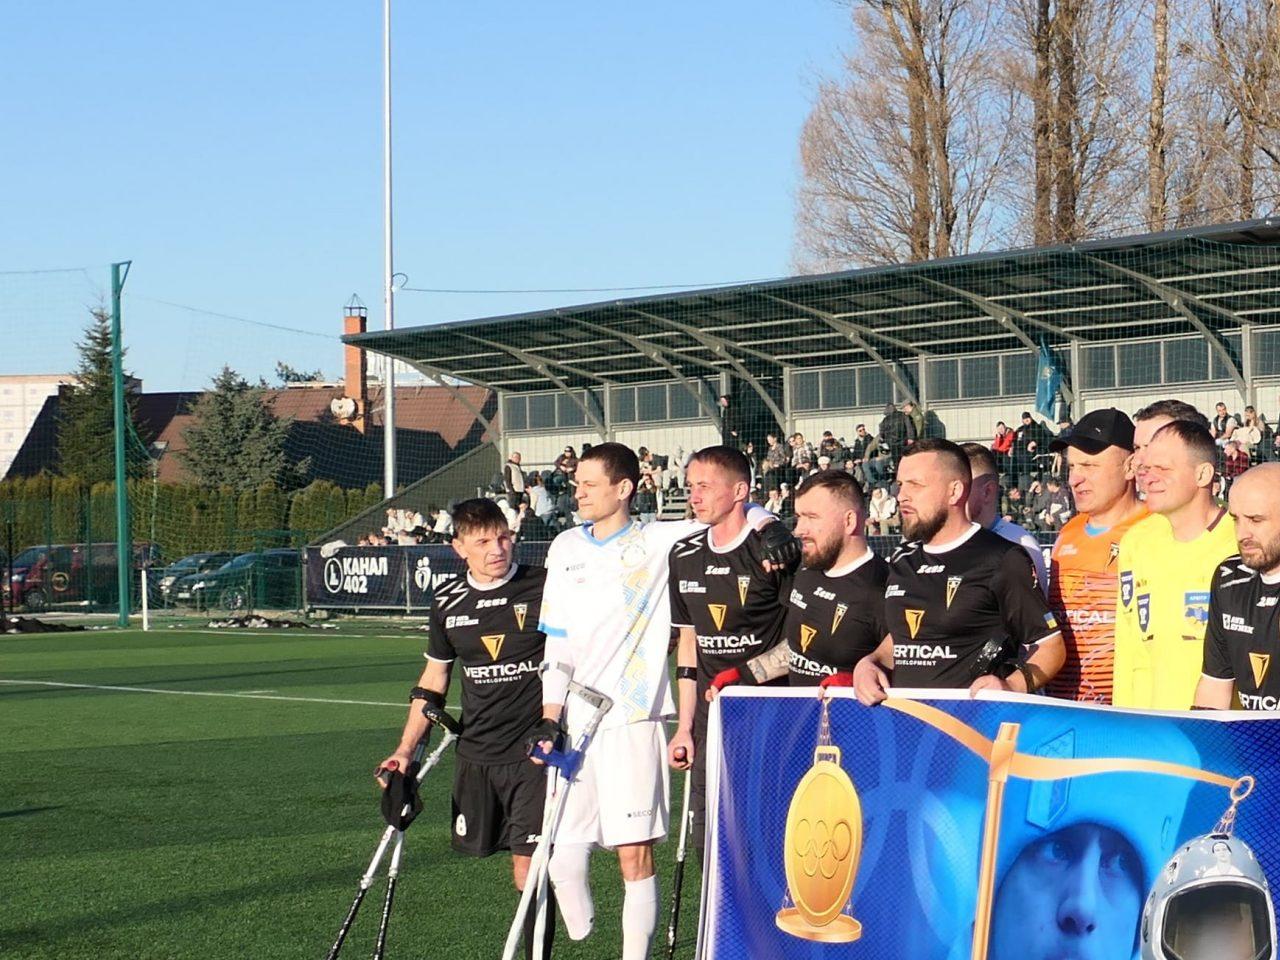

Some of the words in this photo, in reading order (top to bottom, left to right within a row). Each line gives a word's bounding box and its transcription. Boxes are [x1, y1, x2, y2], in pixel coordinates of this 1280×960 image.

[342, 557, 388, 576] КАНАЛ
[343, 576, 367, 593] 402
[696, 634, 763, 648] ERTICAL
[893, 644, 958, 659] ERTICAL
[463, 660, 539, 678] VERTICAL
